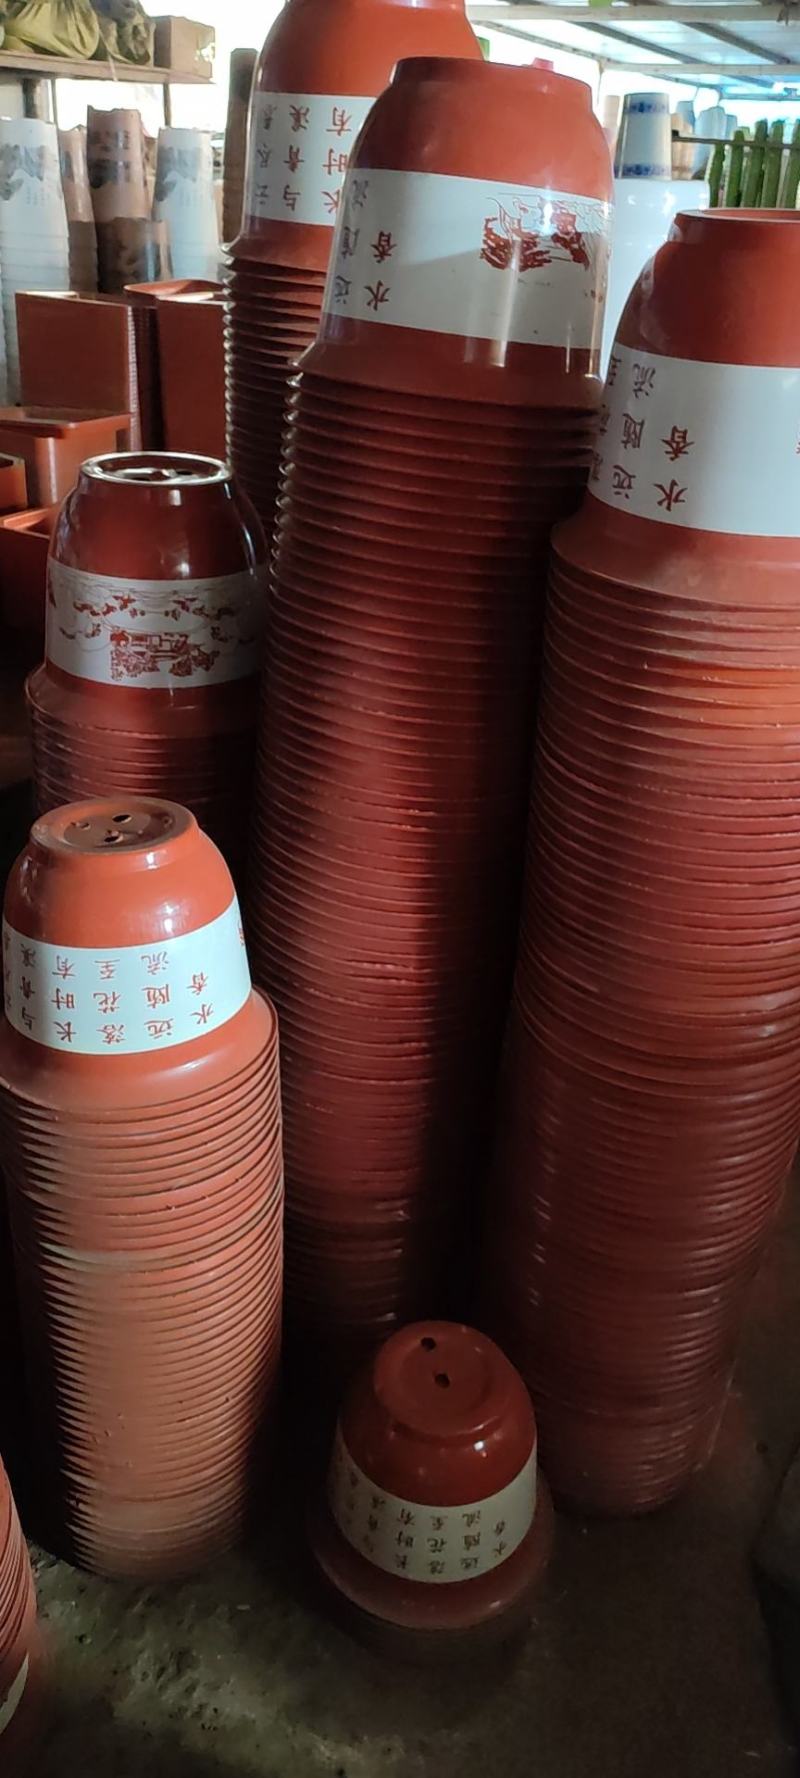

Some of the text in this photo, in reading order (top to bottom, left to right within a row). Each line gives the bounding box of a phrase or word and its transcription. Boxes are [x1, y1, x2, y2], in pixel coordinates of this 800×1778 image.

[283, 104, 310, 211] 与青溪
[364, 230, 396, 311] 水香
[612, 363, 656, 499] 远随流
[653, 425, 695, 512] 水香
[51, 955, 78, 1043] 长时有
[93, 958, 125, 1045] 落花至
[140, 951, 174, 1040] 远随流
[186, 972, 215, 1025] 水香
